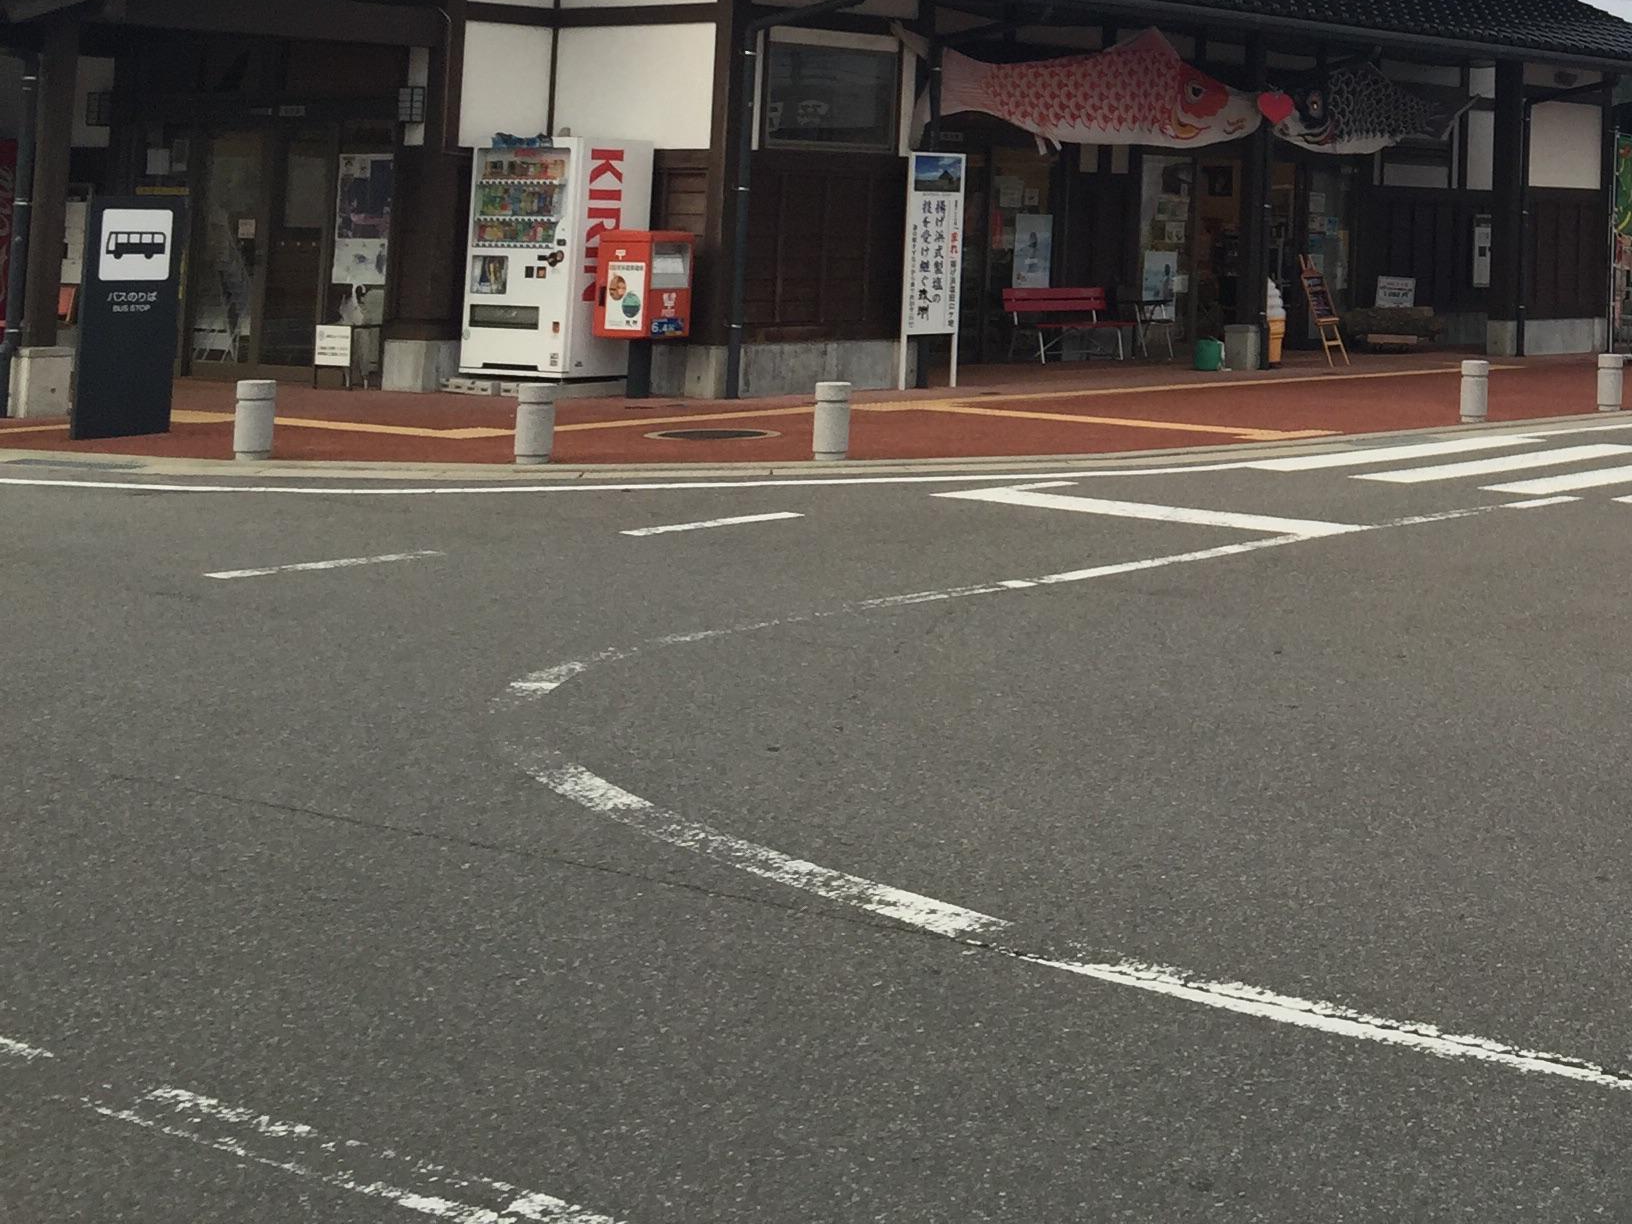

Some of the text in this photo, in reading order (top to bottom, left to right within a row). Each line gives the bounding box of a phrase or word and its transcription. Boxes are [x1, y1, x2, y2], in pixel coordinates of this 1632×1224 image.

[106, 291, 158, 302] バスのりば
[112, 304, 151, 312] BUS STOP
